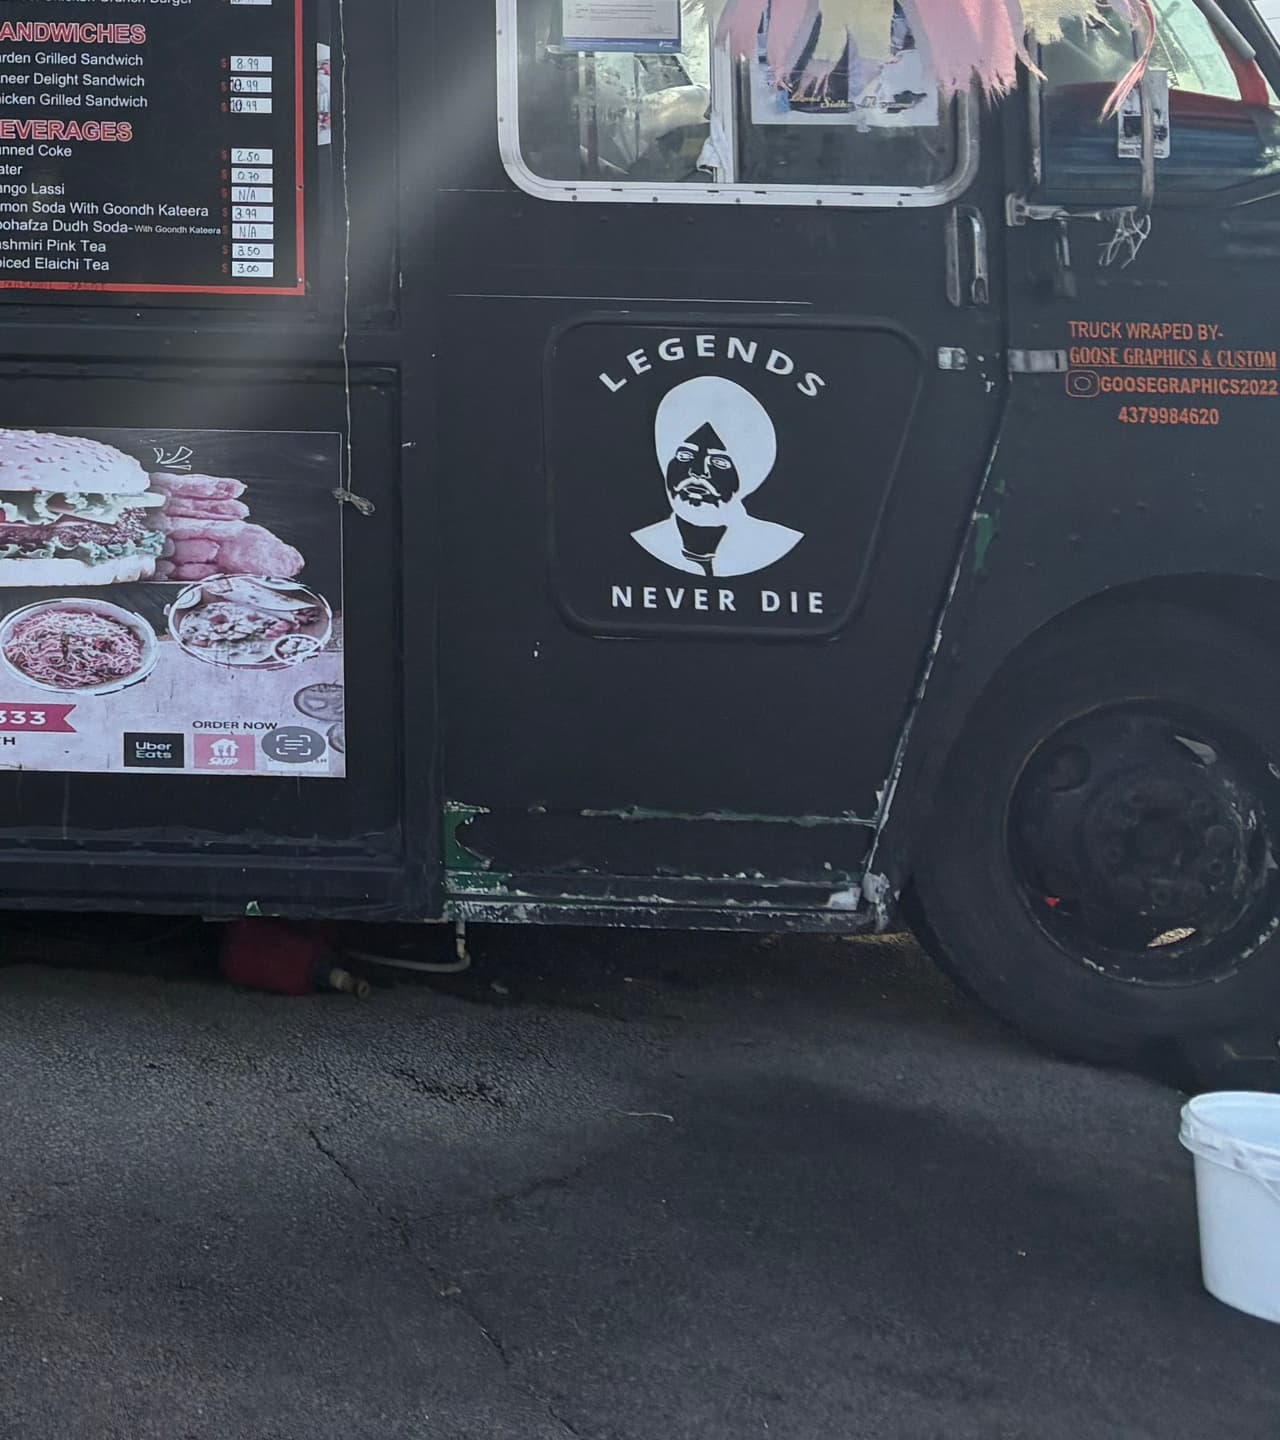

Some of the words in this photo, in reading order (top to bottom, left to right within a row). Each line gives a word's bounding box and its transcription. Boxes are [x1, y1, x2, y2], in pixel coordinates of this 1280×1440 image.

[34, 52, 77, 65] Grilled
[79, 53, 143, 66] Sandwich
[37, 144, 72, 157] Coke
[30, 182, 65, 195] Lassi
[46, 238, 76, 251] Pink
[79, 239, 106, 252] Tea
[1068, 321, 1122, 339] TRUCK
[1126, 323, 1193, 340] WRAPED
[1070, 346, 1120, 365] GOOSE
[1124, 348, 1197, 366] GRAPHICS
[1202, 350, 1212, 367] &
[1217, 350, 1277, 368] CUSTOM
[599, 334, 826, 400] LEGENDS
[1101, 376, 1279, 395] GOOSEGRAPHICS2022
[1118, 407, 1220, 424] 4379984620
[610, 585, 737, 613] NEVER
[761, 589, 824, 614] DIE
[192, 720, 240, 730] ORDER
[243, 722, 278, 730] NOW
[136, 741, 172, 751] Uber
[136, 751, 172, 759] Eats
[207, 757, 239, 766] SKIP
